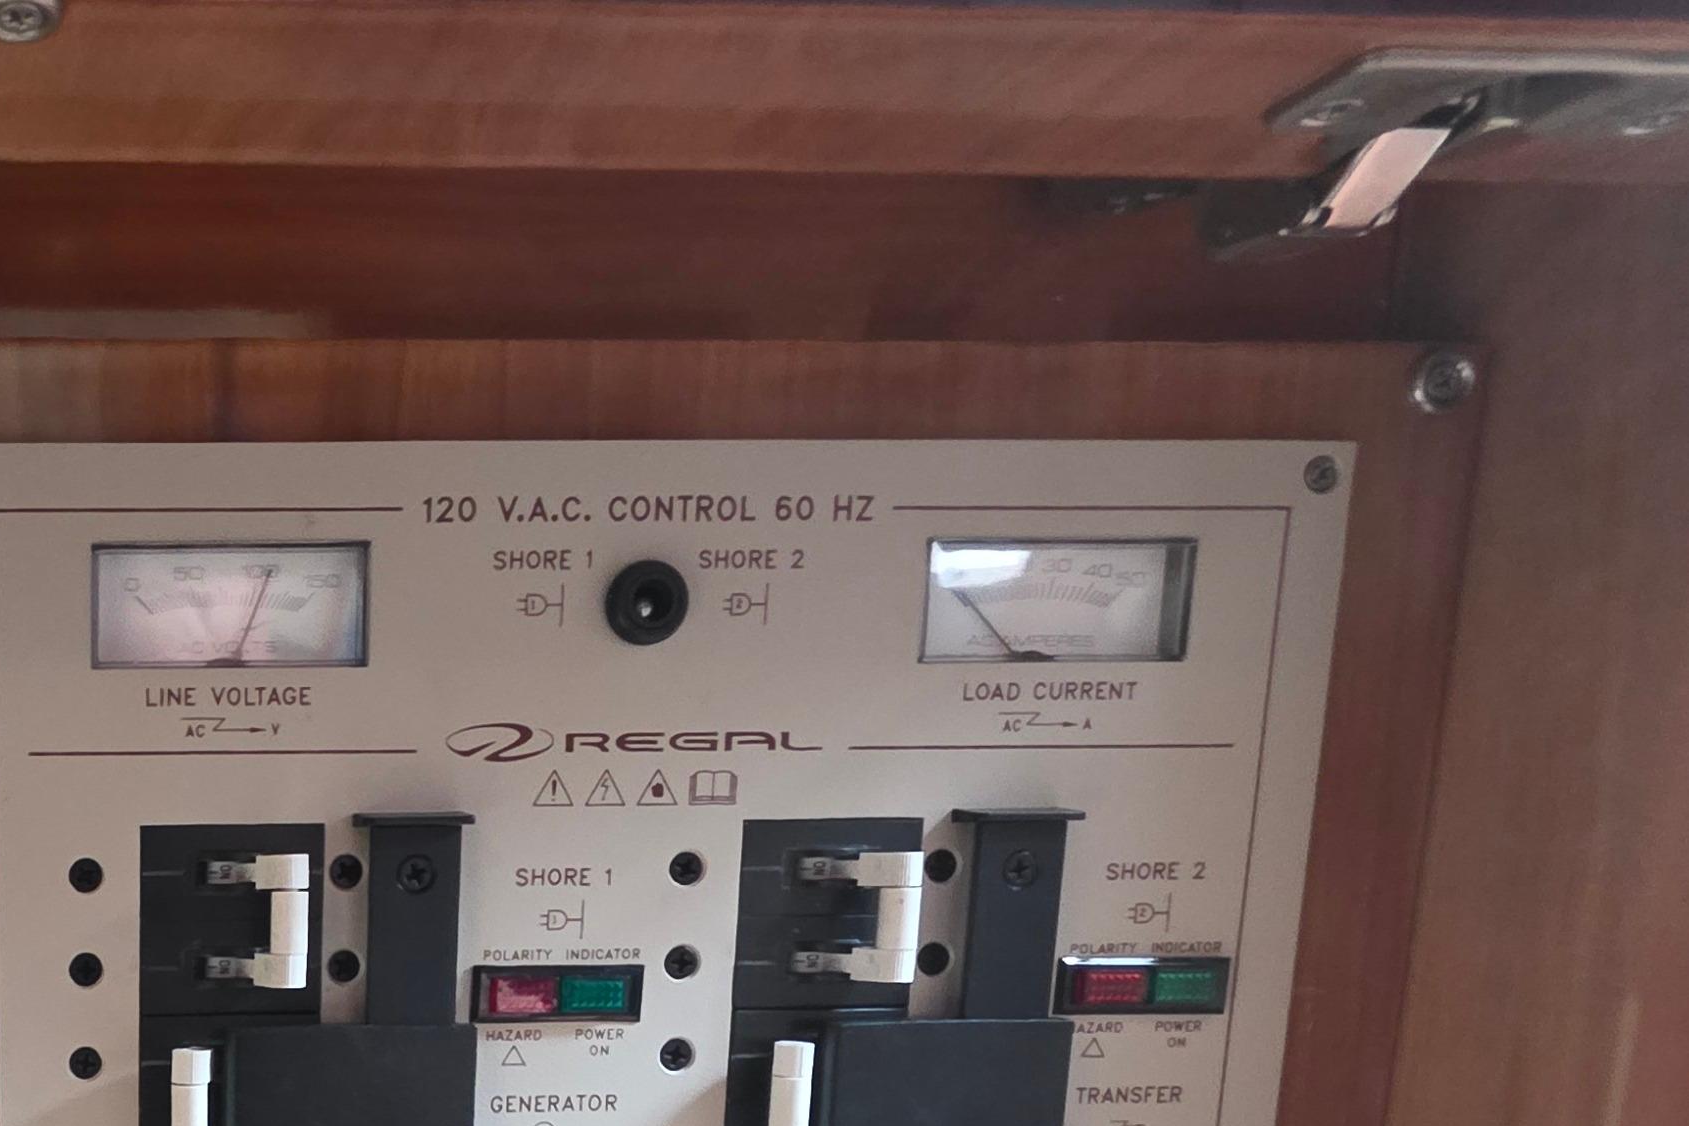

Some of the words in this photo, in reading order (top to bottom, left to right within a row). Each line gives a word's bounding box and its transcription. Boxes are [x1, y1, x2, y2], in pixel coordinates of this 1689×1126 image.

[422, 495, 477, 524] 120
[497, 495, 592, 523] V.A.C.
[608, 494, 756, 523] CONTROL
[775, 495, 815, 522] 60
[832, 494, 875, 522] HZ
[493, 548, 572, 571] SHORE
[586, 549, 593, 569] 1
[698, 549, 778, 570] SHORE
[790, 548, 805, 569] 2
[1041, 556, 1075, 574] 30
[145, 687, 197, 708] LINE
[210, 686, 312, 707] VOLTAGE
[962, 681, 1021, 702] LOAD
[1033, 680, 1138, 701] CURRENT
[185, 724, 206, 738] AC
[564, 731, 823, 753] REGAL
[515, 867, 592, 888] SHORE
[604, 867, 612, 886] 1
[1105, 861, 1181, 881] SHORE
[1191, 861, 1207, 880] 2
[482, 948, 553, 962] POLARITY
[565, 947, 641, 961] INDICATOR
[1070, 943, 1137, 954] POLARITY
[1151, 942, 1221, 953] INDICATOR
[485, 1028, 543, 1042] HAZARD
[574, 1028, 625, 1041] POWER
[1154, 1019, 1203, 1033] POWER
[589, 1044, 610, 1057] ON
[490, 1094, 618, 1114] GENERATOR
[1075, 1085, 1183, 1105] TRANSFER
